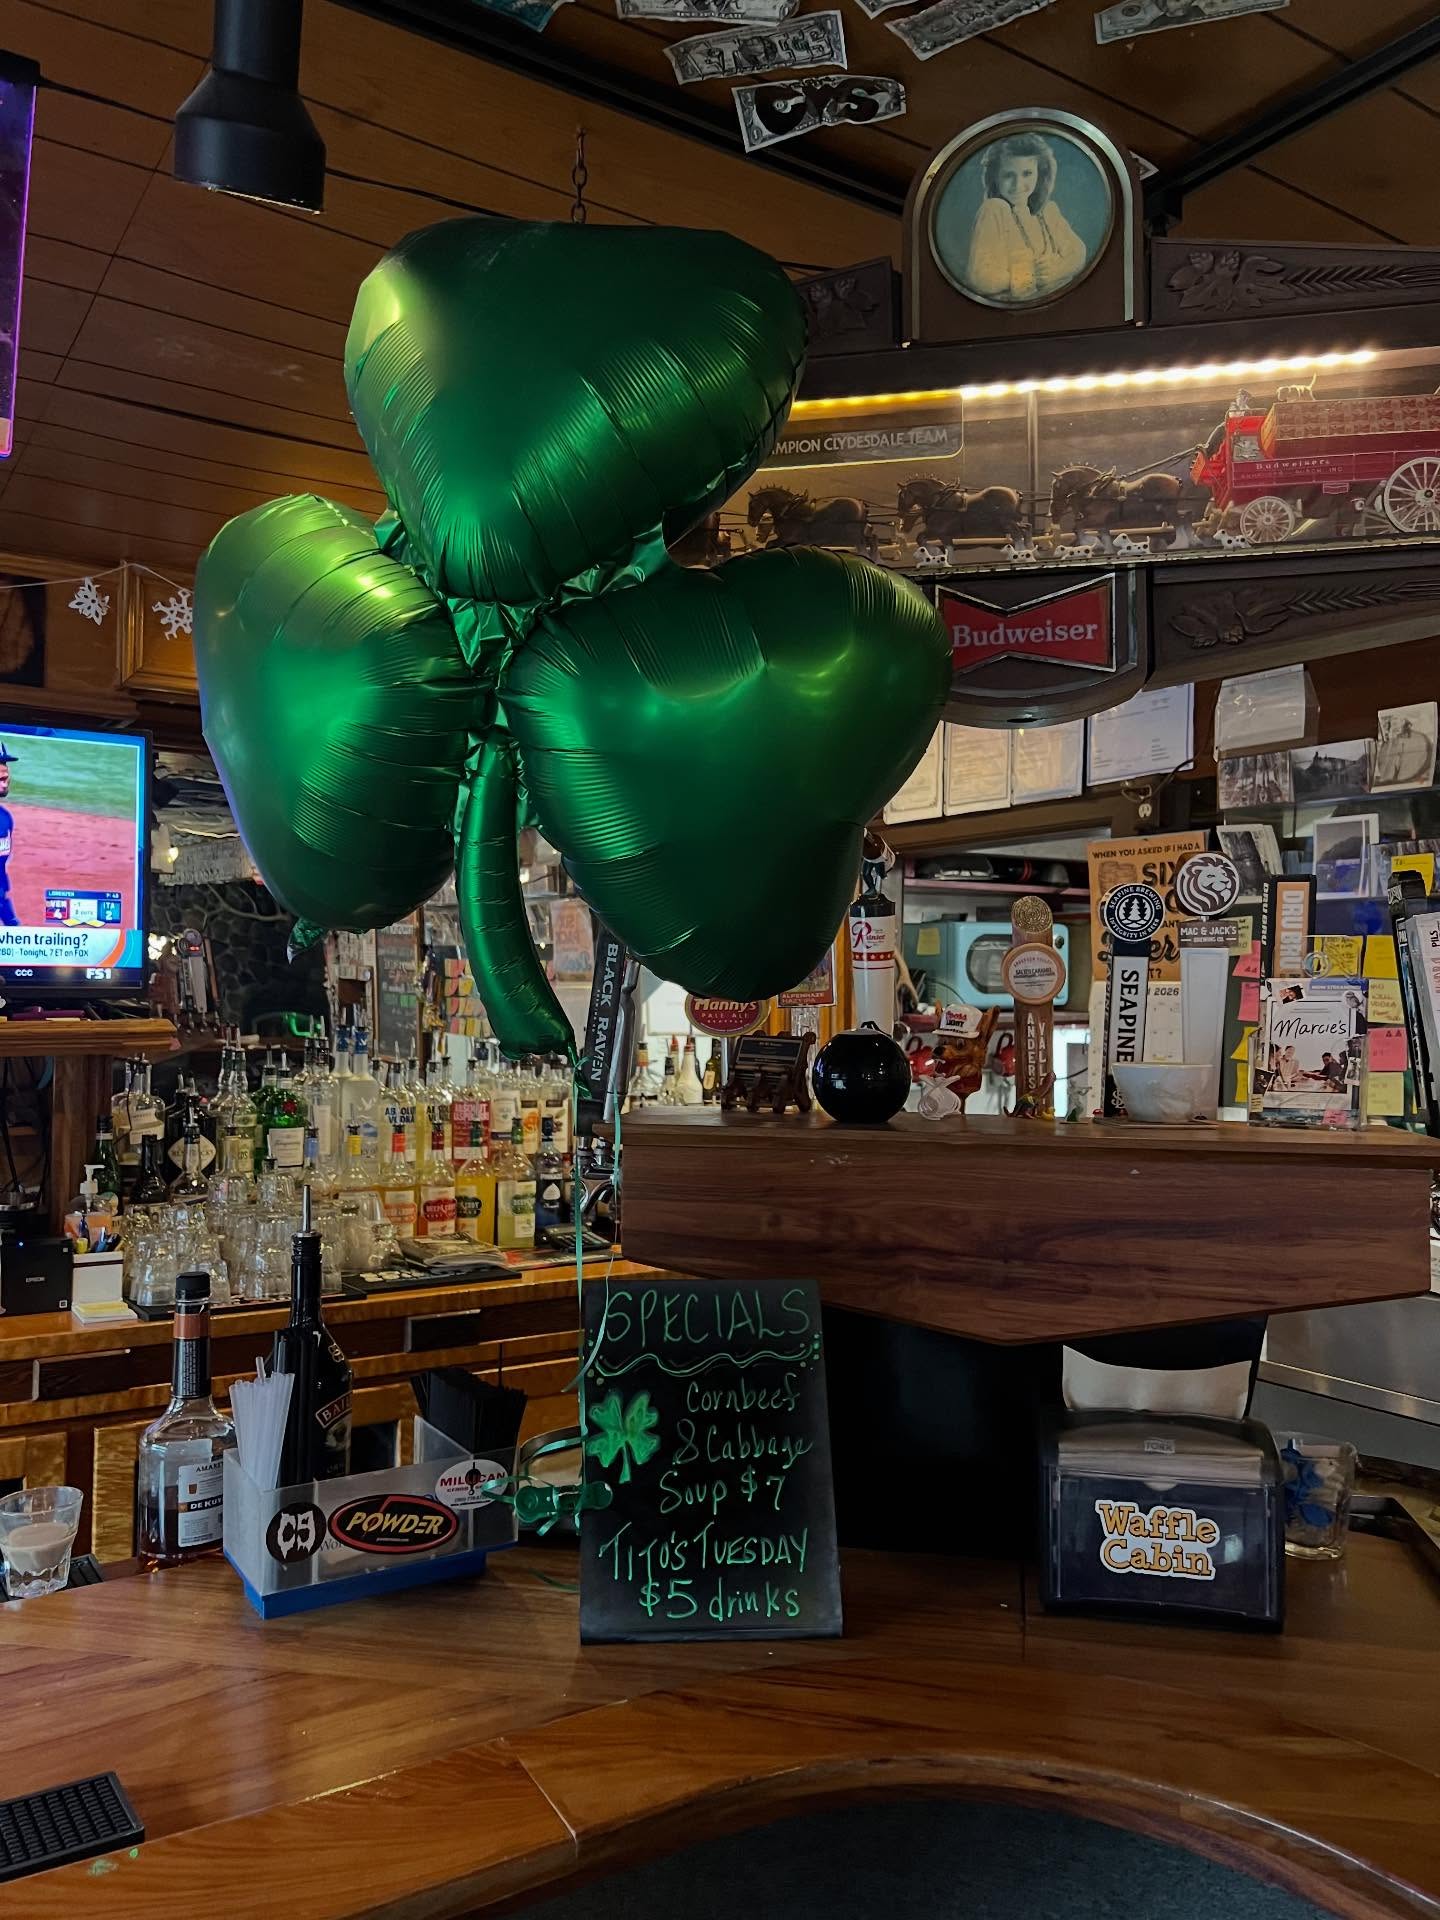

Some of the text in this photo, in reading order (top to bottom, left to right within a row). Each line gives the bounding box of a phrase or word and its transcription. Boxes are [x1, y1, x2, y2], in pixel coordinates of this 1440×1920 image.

[823, 432, 904, 451] CLYDESDALE
[909, 429, 948, 444] TEAM
[952, 620, 1098, 648] Budweiser
[1092, 851, 1117, 860] WHEN
[1119, 848, 1135, 857] YOU
[1137, 846, 1162, 856] ASKED
[1164, 845, 1171, 853] IF
[1177, 843, 1194, 851] HAD
[1194, 842, 1200, 850] A
[105, 910, 113, 920] 2
[1109, 886, 1135, 911] SEAPINE
[1135, 886, 1161, 911] BREWING
[34, 933, 89, 949] trailing?
[1180, 925, 1237, 936] MAC & JACK'S
[601, 943, 619, 1007] BLACK
[1153, 987, 1179, 996] 2026
[1116, 969, 1139, 1063] SEAPINE
[1274, 1017, 1347, 1040] Marcie's
[590, 1017, 610, 1081] RAVEN
[1027, 1012, 1037, 1089] ANDERS
[605, 1289, 811, 1347] SPECIALS
[686, 1373, 800, 1413] Cornbeef
[706, 1426, 813, 1470] Cabbage
[440, 1471, 505, 1487] MILCAN
[660, 1470, 728, 1516] Soup
[346, 1511, 442, 1535] POWDER
[1099, 1504, 1217, 1543] Waffle
[598, 1522, 809, 1580] TITO'S TUESDAY
[1103, 1539, 1213, 1577] Cabin
[639, 1577, 800, 1622] $5 drinks
